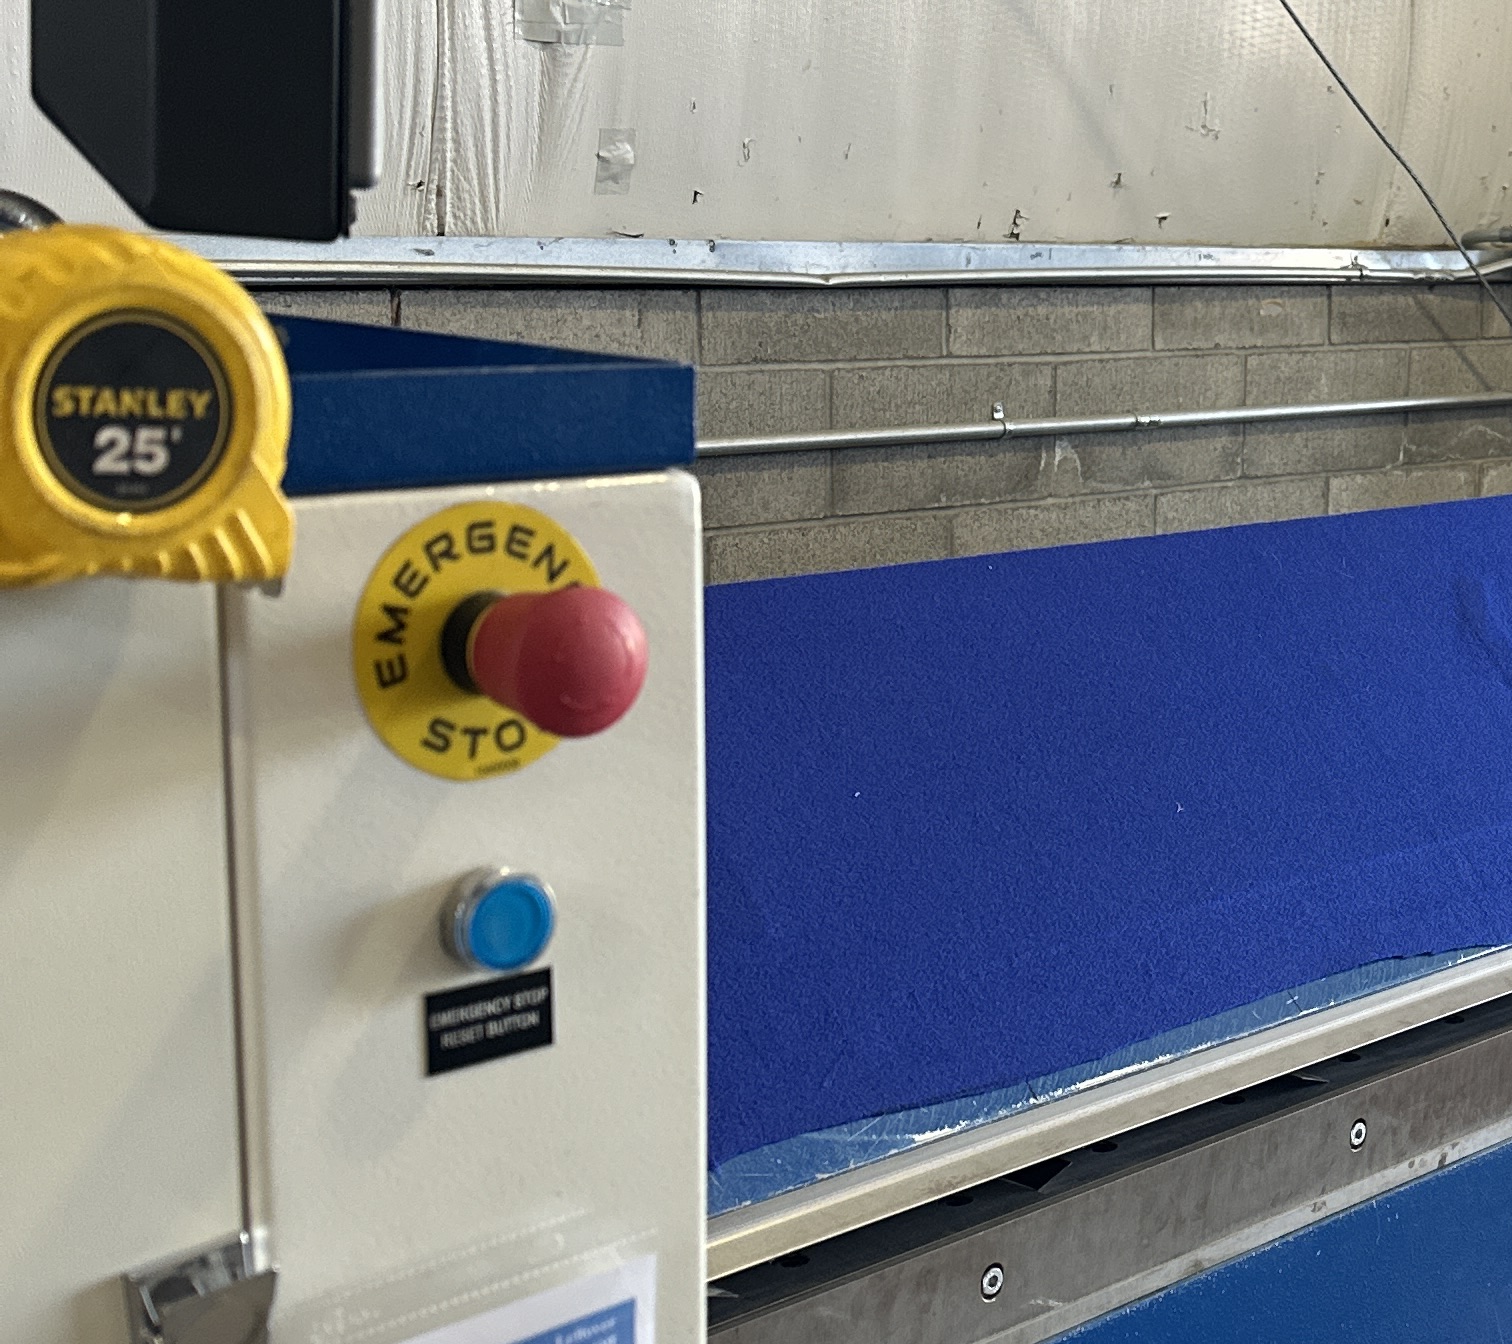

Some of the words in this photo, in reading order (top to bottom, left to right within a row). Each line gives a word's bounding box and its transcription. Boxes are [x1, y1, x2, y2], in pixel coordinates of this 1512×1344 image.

[51, 383, 213, 420] STANLEY
[92, 422, 184, 477] 25'
[373, 519, 580, 690] EMERGEN
[420, 716, 528, 760] STO
[512, 985, 549, 1011] STOP
